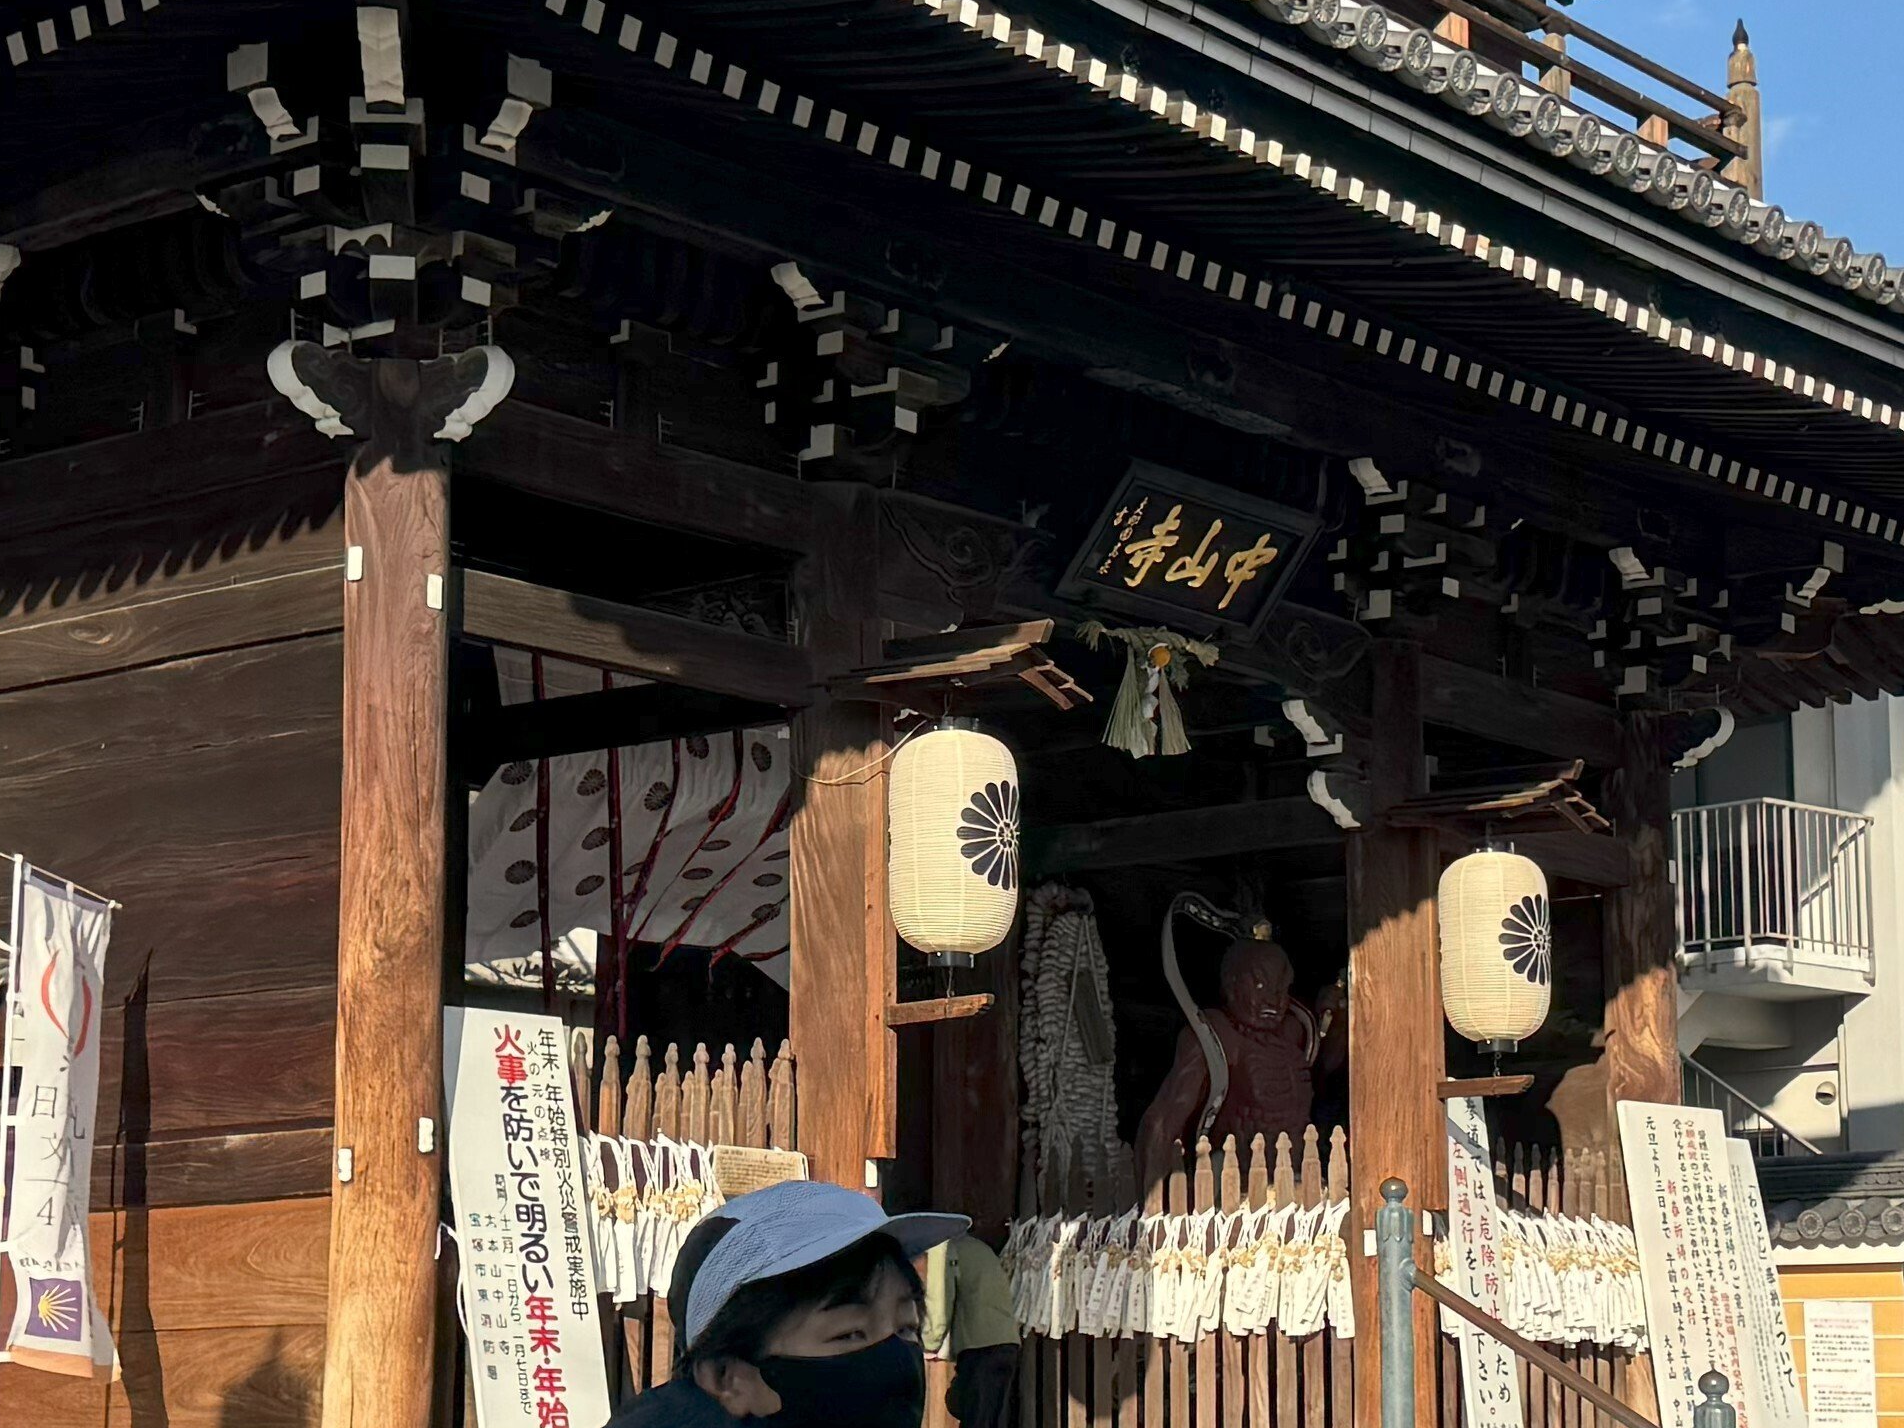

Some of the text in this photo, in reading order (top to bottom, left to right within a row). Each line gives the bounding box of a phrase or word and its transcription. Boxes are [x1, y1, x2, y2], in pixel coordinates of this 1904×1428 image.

[1124, 504, 1278, 610] 中山寺
[1452, 1141, 1496, 1416] 左側通行をし下さい。
[1462, 1097, 1512, 1404] 参道では、危険防止ため
